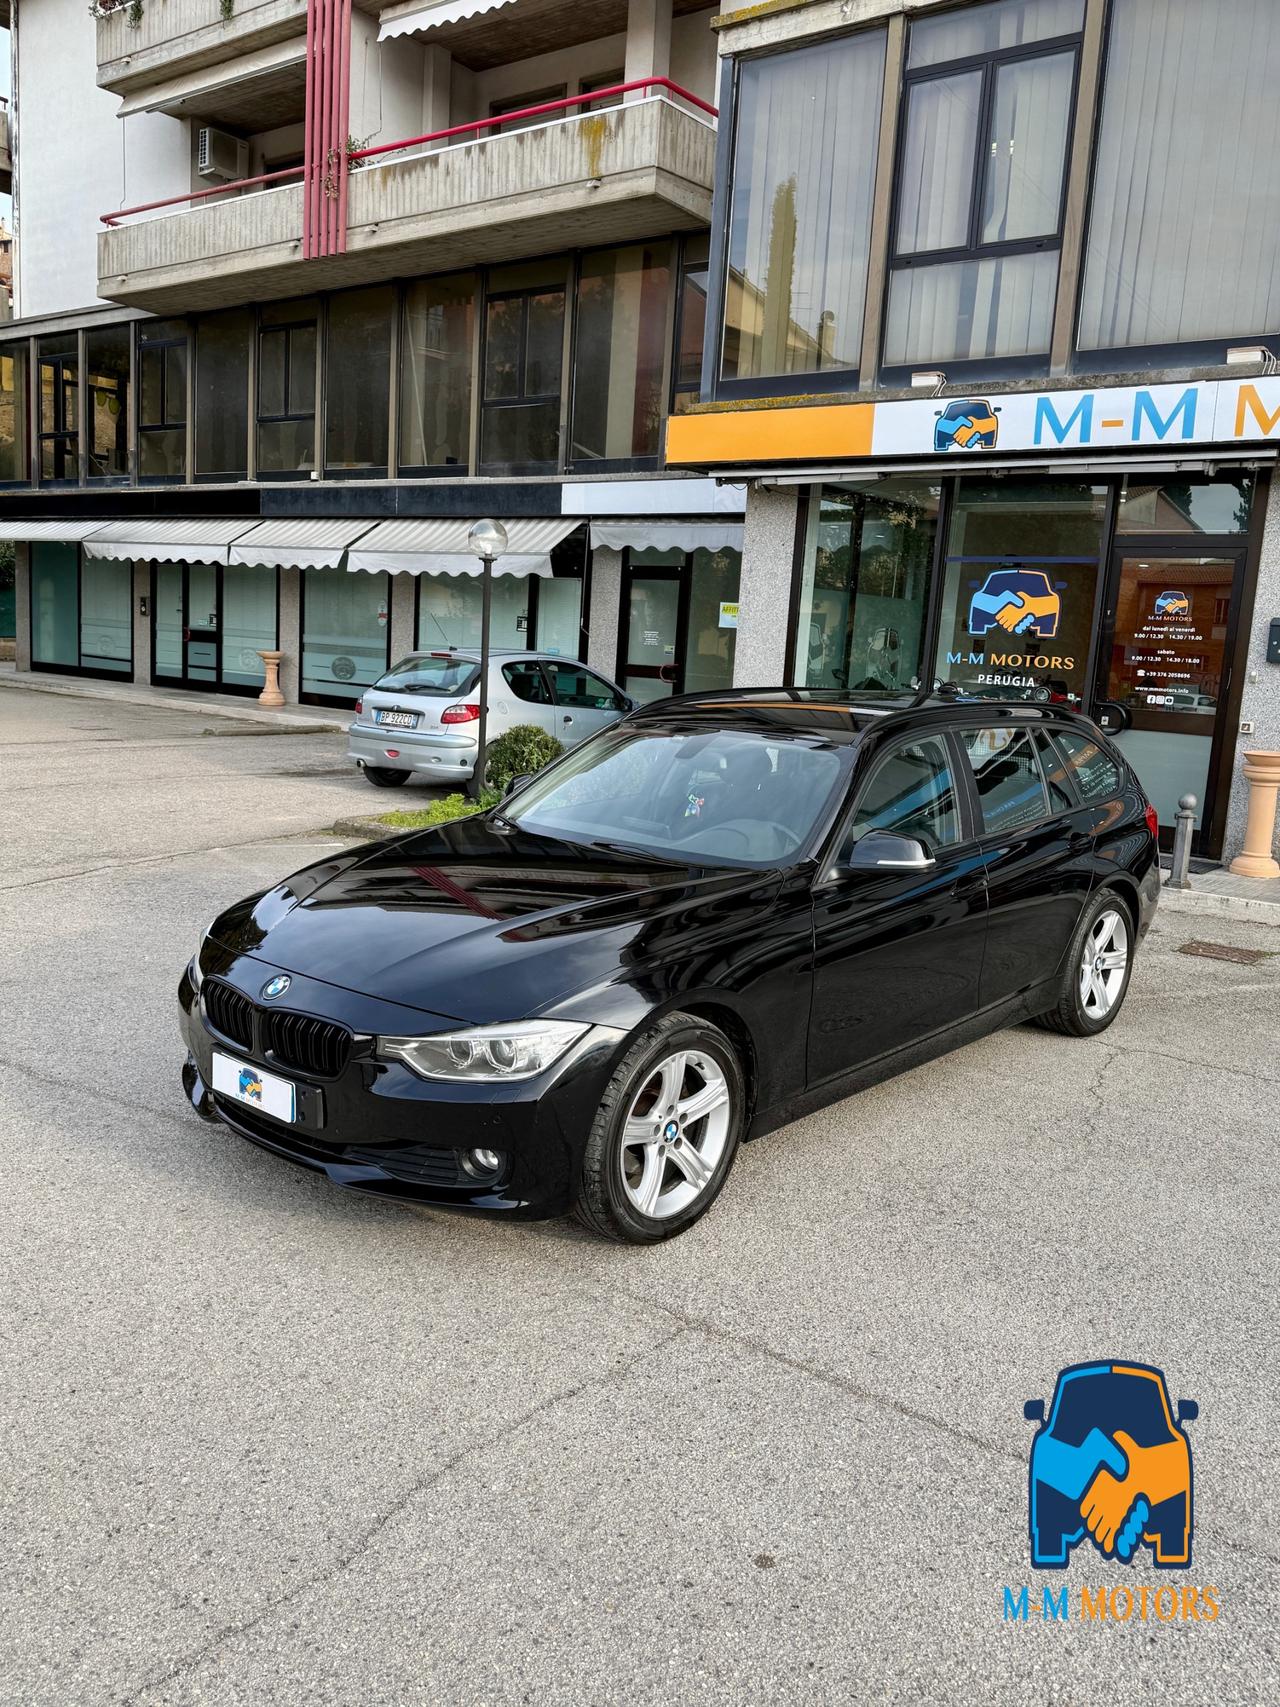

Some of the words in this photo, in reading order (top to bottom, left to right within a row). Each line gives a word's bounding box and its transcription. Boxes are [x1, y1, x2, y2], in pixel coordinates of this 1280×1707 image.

[1034, 388, 1199, 445] M-M
[946, 652, 984, 665] M-M
[990, 653, 1075, 670] MOTORS
[977, 674, 1036, 687] PERUGIA
